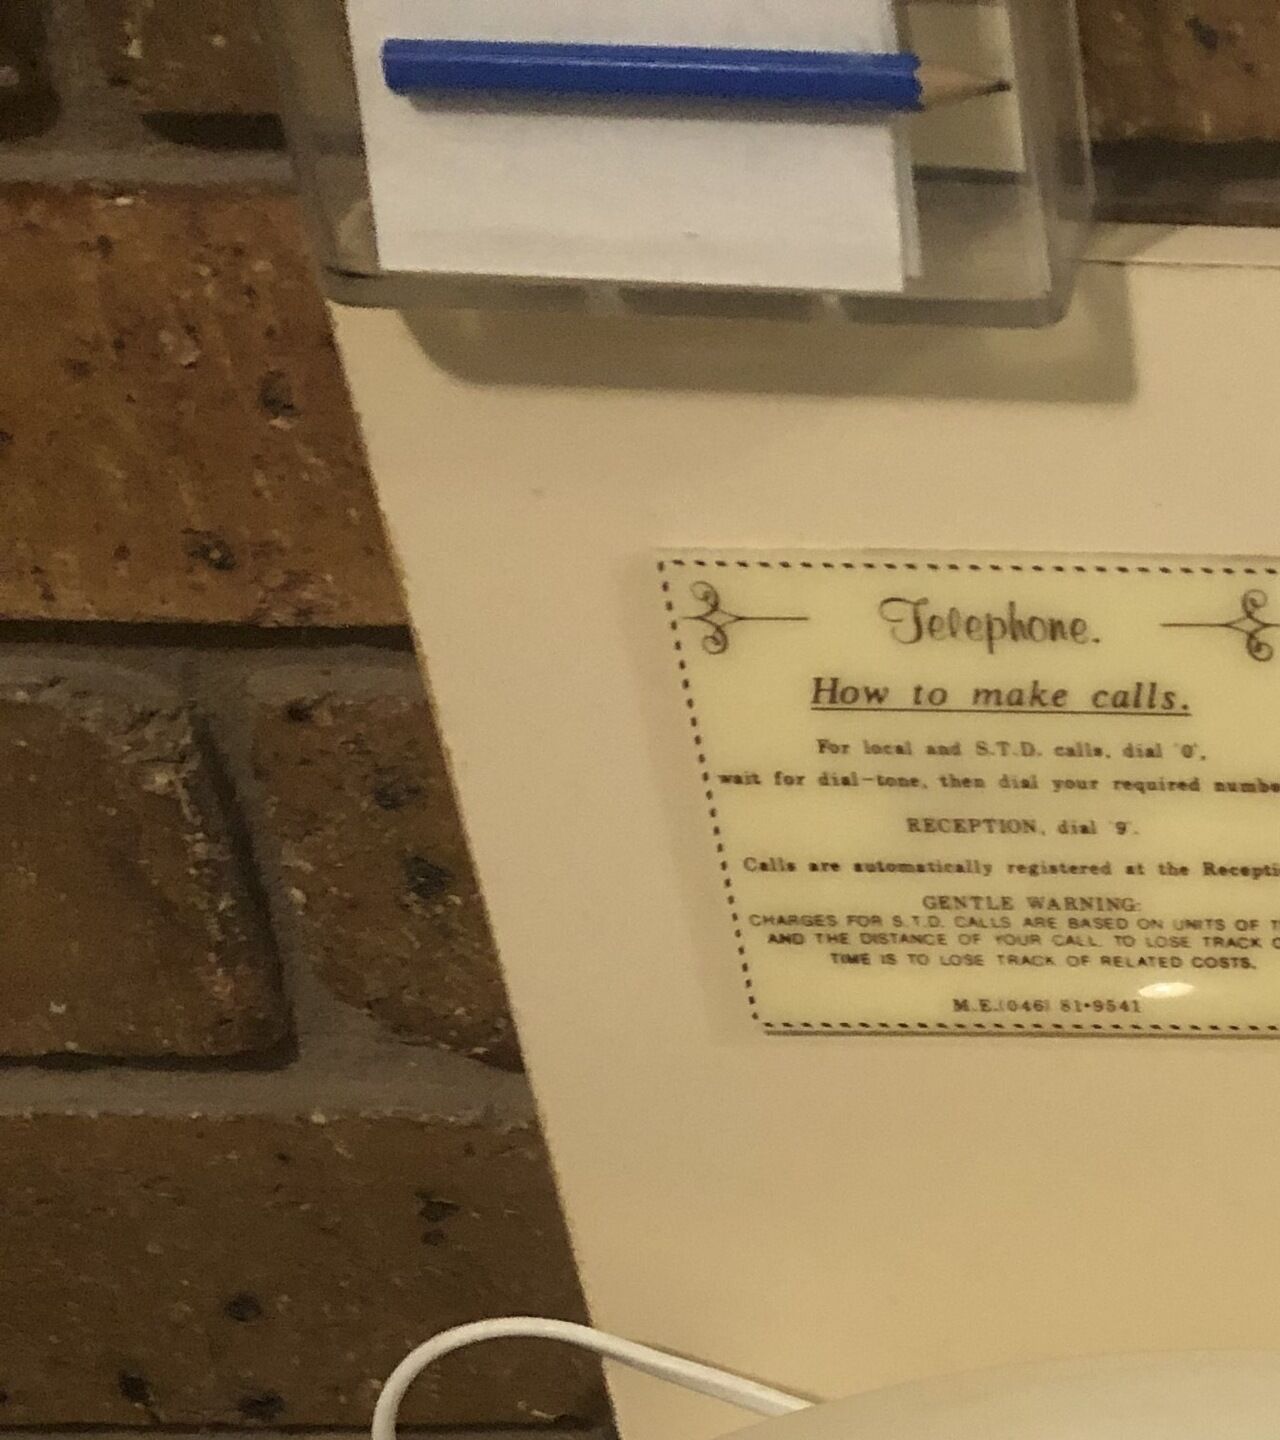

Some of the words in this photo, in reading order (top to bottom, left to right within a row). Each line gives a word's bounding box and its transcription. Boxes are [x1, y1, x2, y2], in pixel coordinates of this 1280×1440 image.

[878, 596, 1101, 655] Telephone.
[811, 676, 891, 705] How
[912, 684, 948, 707] to
[972, 679, 1070, 708] make
[1092, 681, 1190, 711] calls.
[816, 738, 851, 755] For
[862, 738, 913, 756] local
[925, 741, 962, 756] and
[1121, 741, 1164, 759] dial
[717, 771, 762, 786] wait
[773, 770, 806, 786] for
[938, 772, 986, 789] then
[998, 773, 1039, 790] dial
[1051, 777, 1100, 794] your
[1112, 776, 1201, 795] required
[1056, 819, 1099, 835] dial
[742, 856, 797, 873] Calls
[807, 860, 841, 874] are
[852, 858, 993, 877] automatically
[1006, 860, 1113, 877] registered
[1124, 862, 1146, 876] at
[1157, 861, 1191, 877] the
[921, 895, 1015, 912] GENTLE
[748, 914, 839, 928] CHARGES
[846, 914, 883, 928] FOR
[953, 915, 1012, 929] CALLS
[1022, 917, 1058, 930] ARE
[1067, 917, 1129, 931] BASED
[1136, 918, 1164, 931] ON
[1171, 918, 1226, 932] UNITS
[1234, 918, 1260, 932] OF
[766, 932, 806, 946] AND
[815, 932, 849, 946] THE
[859, 932, 947, 947] DISTANCE
[957, 933, 982, 946] OF
[995, 934, 1042, 947] YOUR
[1113, 935, 1137, 948] TO
[1145, 936, 1192, 949] LOSE
[1201, 936, 1263, 950] TRACK
[830, 952, 871, 966] TIME
[880, 952, 898, 966] IS
[906, 953, 931, 966] TO
[939, 954, 985, 967] LOSE
[996, 954, 1056, 968] TRACK
[1066, 955, 1091, 968] OF
[1099, 955, 1184, 969] RELATED
